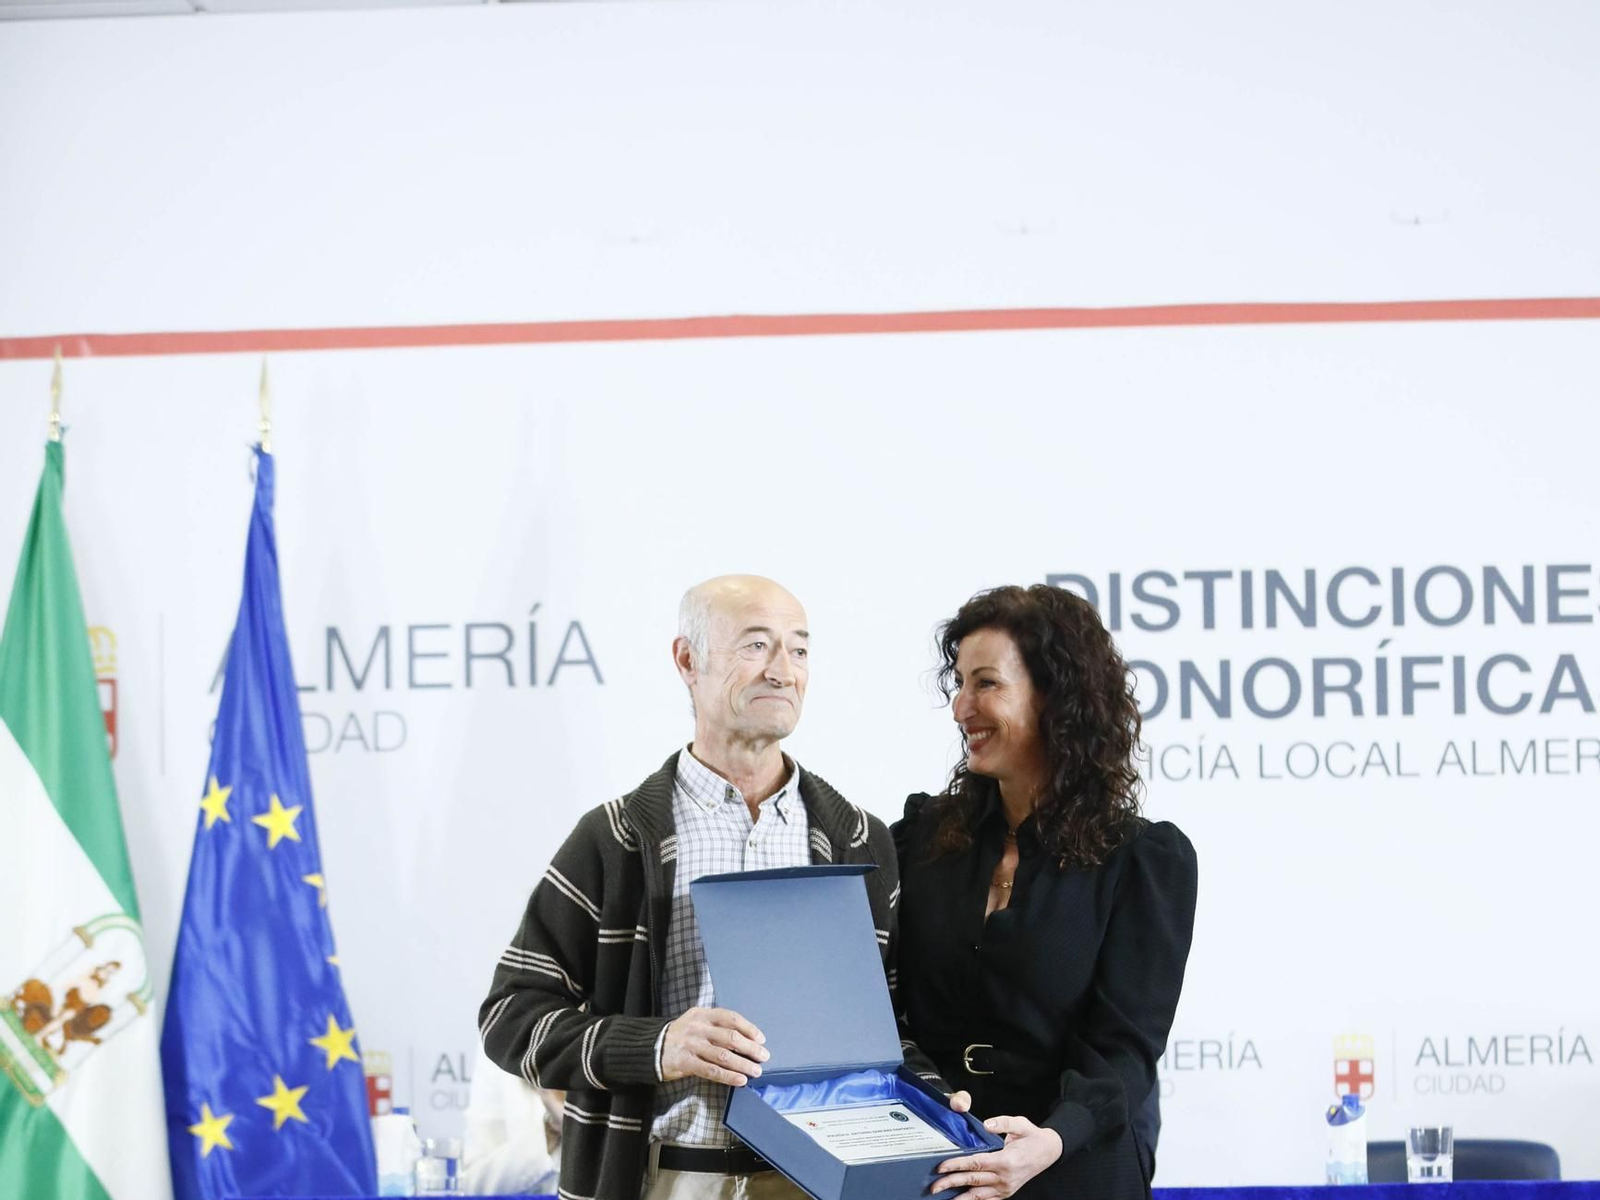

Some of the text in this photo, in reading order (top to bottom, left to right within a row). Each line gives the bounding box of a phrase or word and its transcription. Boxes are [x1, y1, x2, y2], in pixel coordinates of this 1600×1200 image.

[1045, 563, 1600, 632] ISTINCIONE
[209, 602, 605, 693] MERÍA
[1257, 739, 1420, 780] LOCAL
[1163, 1030, 1263, 1070] ERÍA
[1414, 1026, 1594, 1067] ALMERÍA
[1413, 1074, 1506, 1095] CIUDAD
